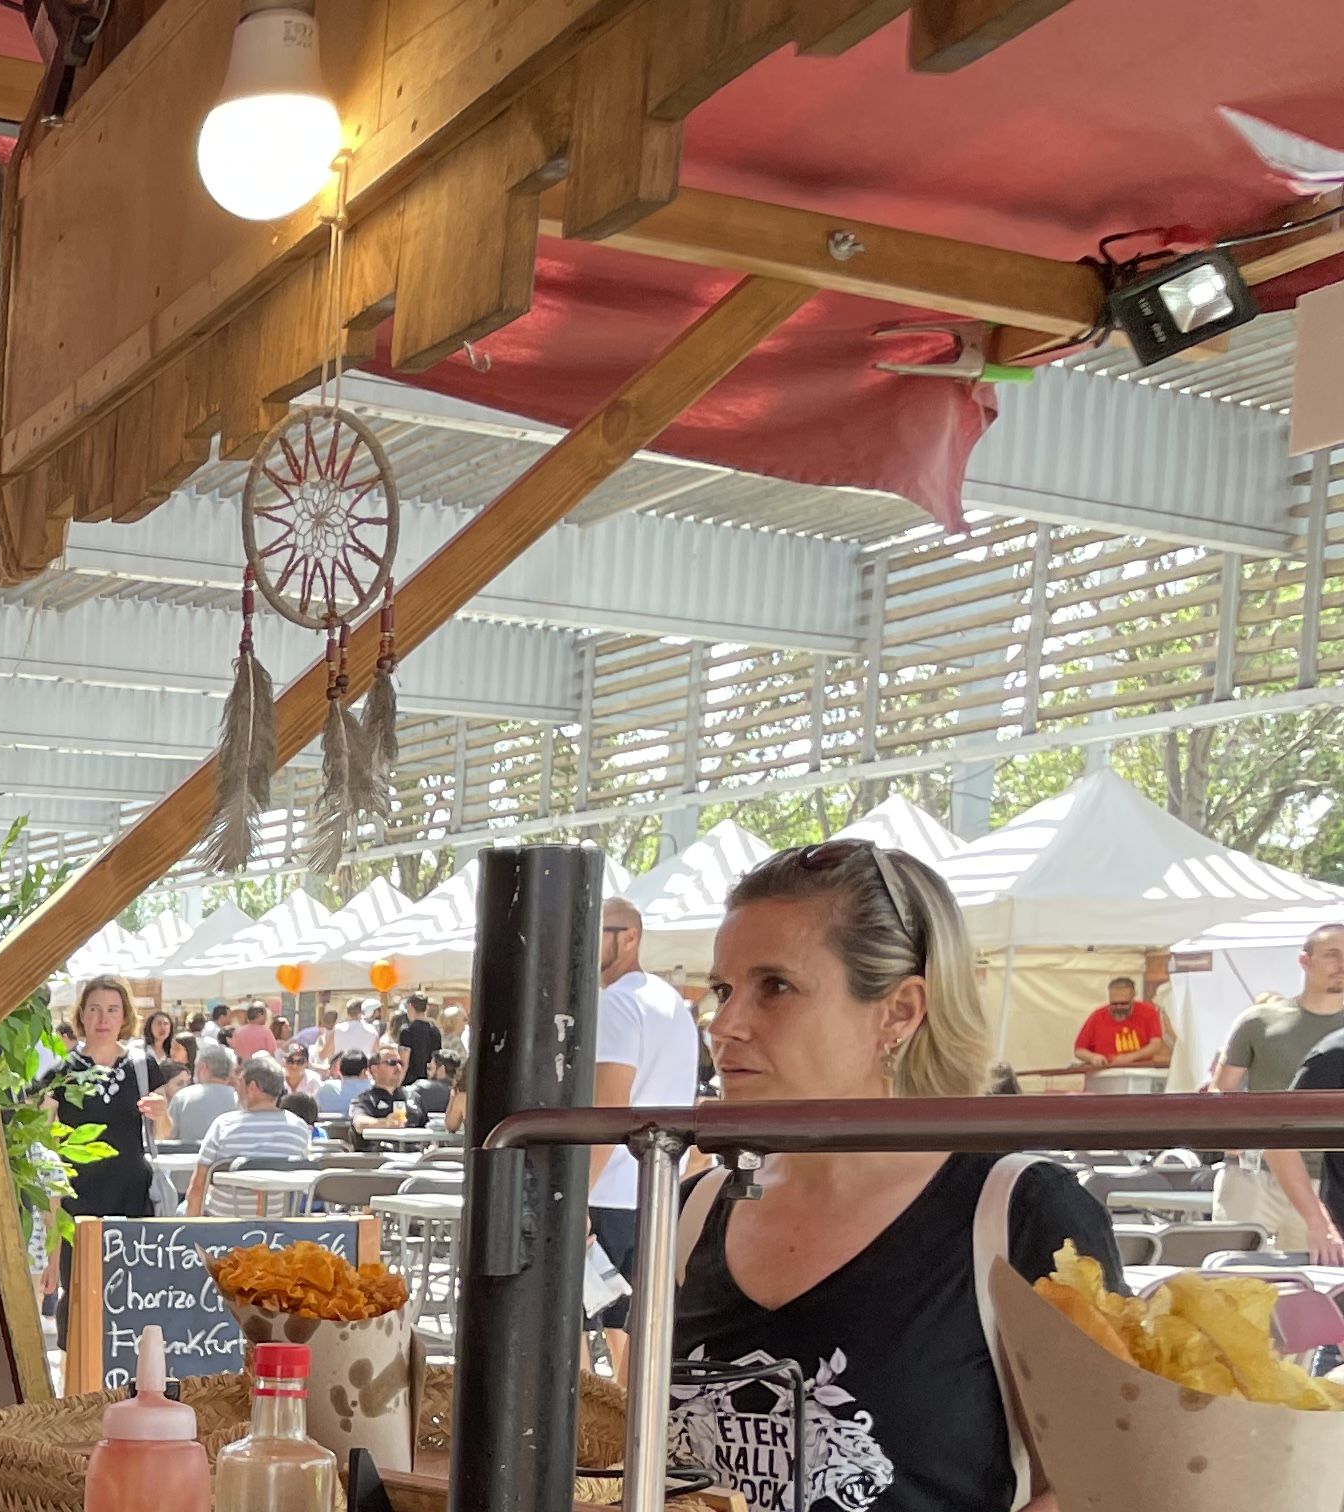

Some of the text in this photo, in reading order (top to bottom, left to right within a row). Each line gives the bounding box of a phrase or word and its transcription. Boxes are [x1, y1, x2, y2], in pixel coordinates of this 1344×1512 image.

[103, 1268, 197, 1314] Chorizo
[105, 1320, 248, 1357] Frnkfurt
[716, 1416, 789, 1449] ETER
[715, 1445, 796, 1481] NALLY
